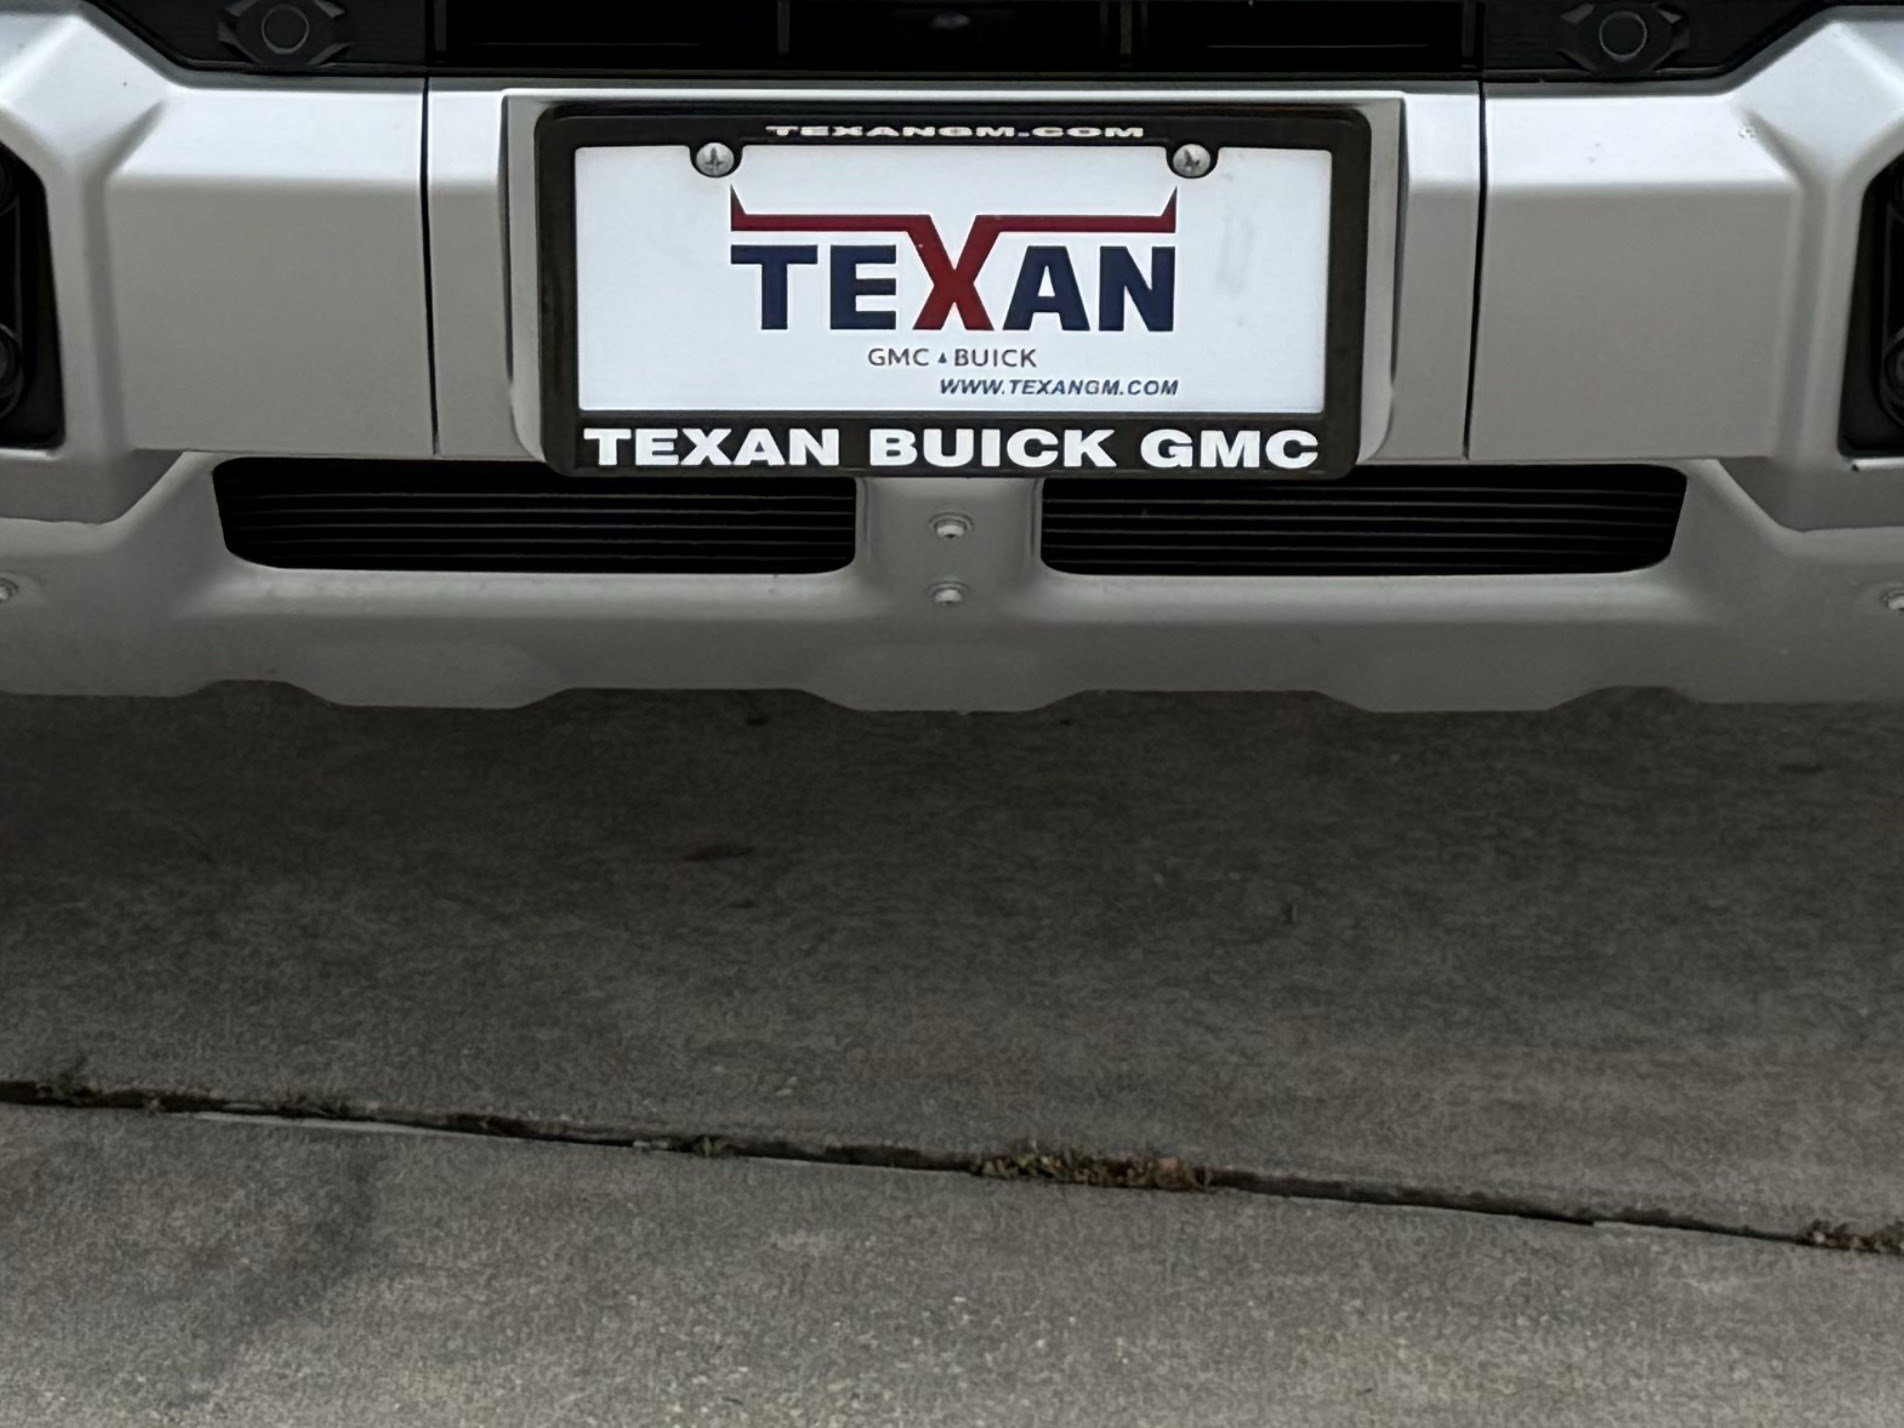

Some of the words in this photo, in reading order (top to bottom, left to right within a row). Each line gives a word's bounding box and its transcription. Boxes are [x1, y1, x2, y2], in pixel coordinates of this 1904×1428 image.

[765, 125, 1144, 137] TEXANGM.COM
[729, 213, 1177, 332] TEXAN
[867, 347, 930, 367] GMC
[953, 348, 1038, 368] BUICK
[939, 378, 1179, 396] WWW.TEXANGM.COM
[582, 427, 840, 467] TEXAN
[869, 428, 1117, 468] BUICK
[1139, 428, 1319, 469] GMC
